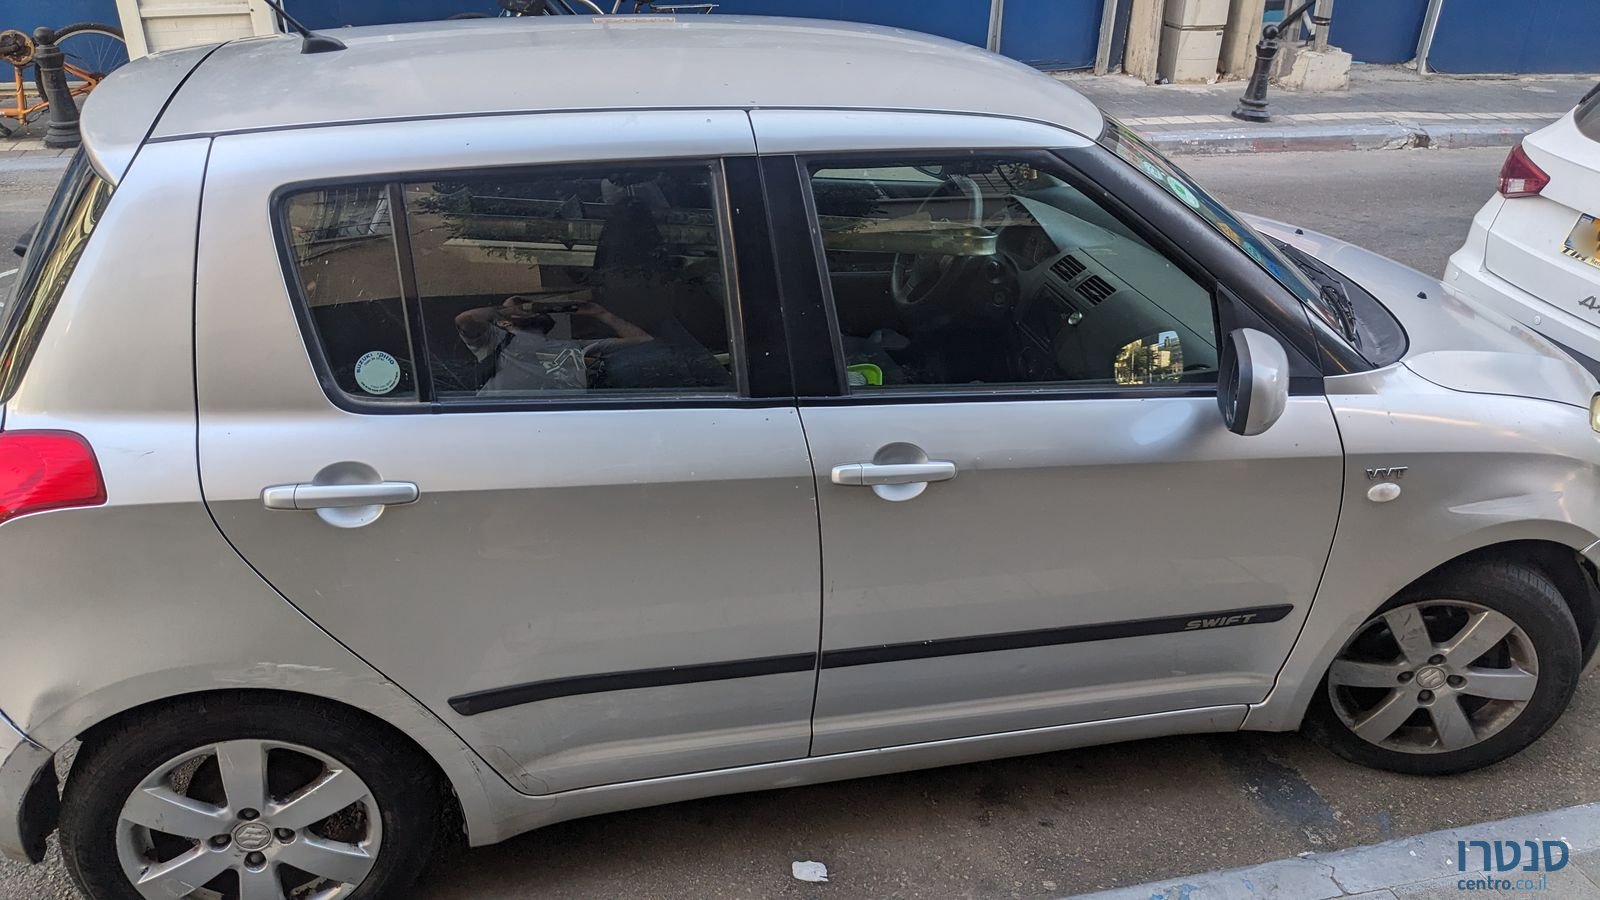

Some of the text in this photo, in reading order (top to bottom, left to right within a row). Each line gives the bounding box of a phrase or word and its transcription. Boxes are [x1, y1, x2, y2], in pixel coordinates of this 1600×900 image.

[356, 352, 373, 374] SUZUKI
[1365, 466, 1408, 480] VVT
[1183, 613, 1257, 631] SWIFT
